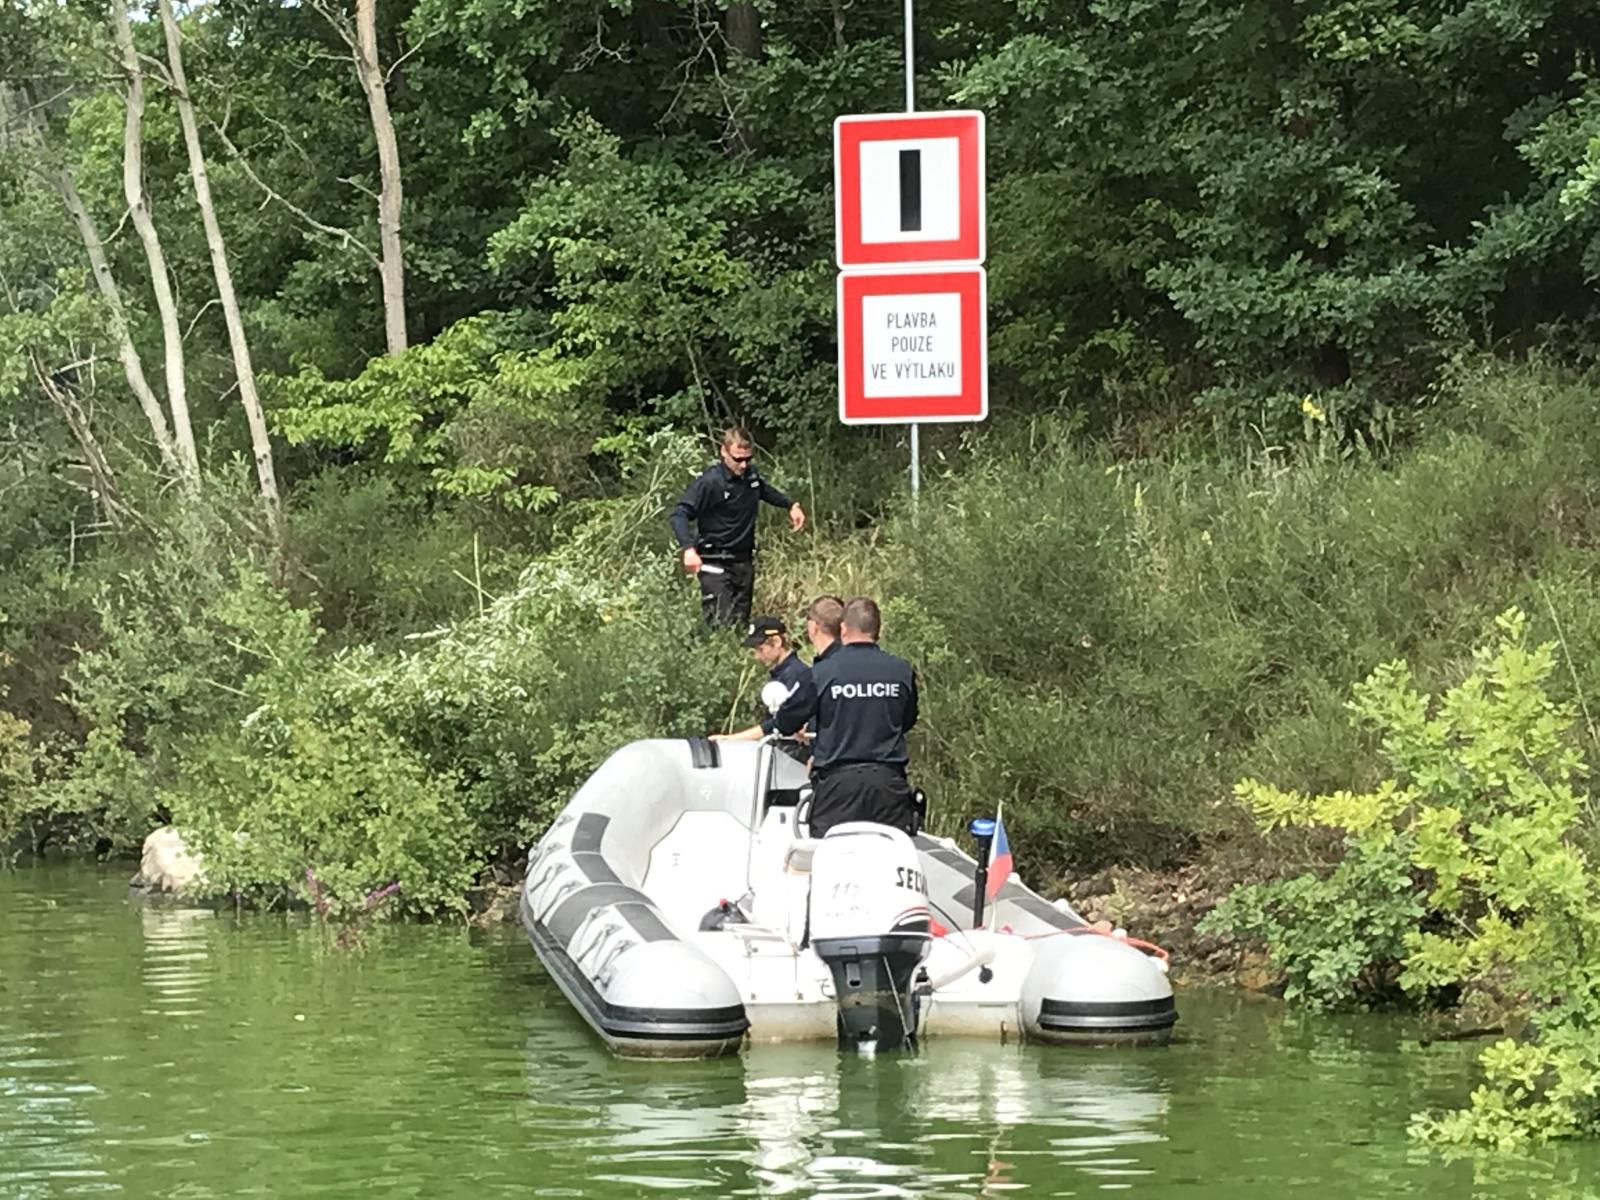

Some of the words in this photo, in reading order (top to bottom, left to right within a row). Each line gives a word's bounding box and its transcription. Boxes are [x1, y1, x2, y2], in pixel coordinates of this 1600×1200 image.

[886, 312, 937, 329] PLAVBA
[891, 336, 933, 352] POUZE
[871, 363, 887, 380] VE
[895, 358, 955, 379] VÝTLAKU
[831, 682, 900, 699] POLICIE
